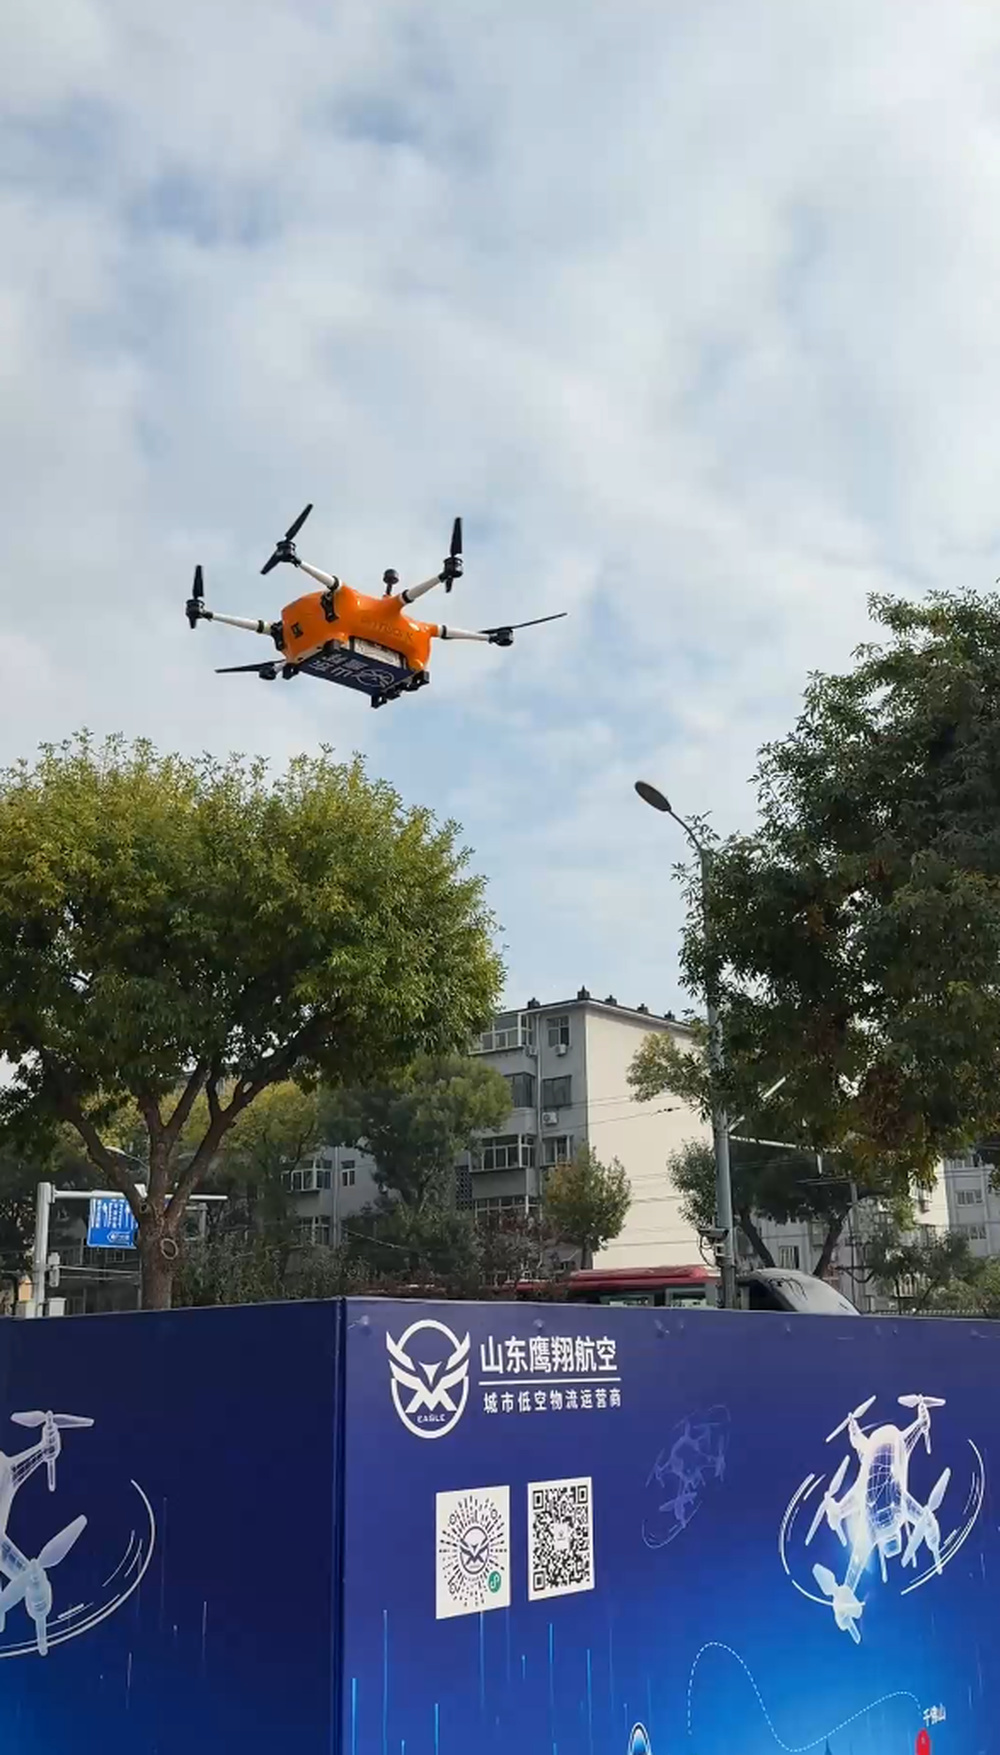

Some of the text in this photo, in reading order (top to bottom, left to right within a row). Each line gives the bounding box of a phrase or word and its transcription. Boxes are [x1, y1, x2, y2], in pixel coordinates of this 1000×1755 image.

[480, 1335, 618, 1374] 山东鹰翔航空
[483, 1388, 621, 1414] 城市低空物流运营商
[417, 1413, 446, 1423] EAGLE
